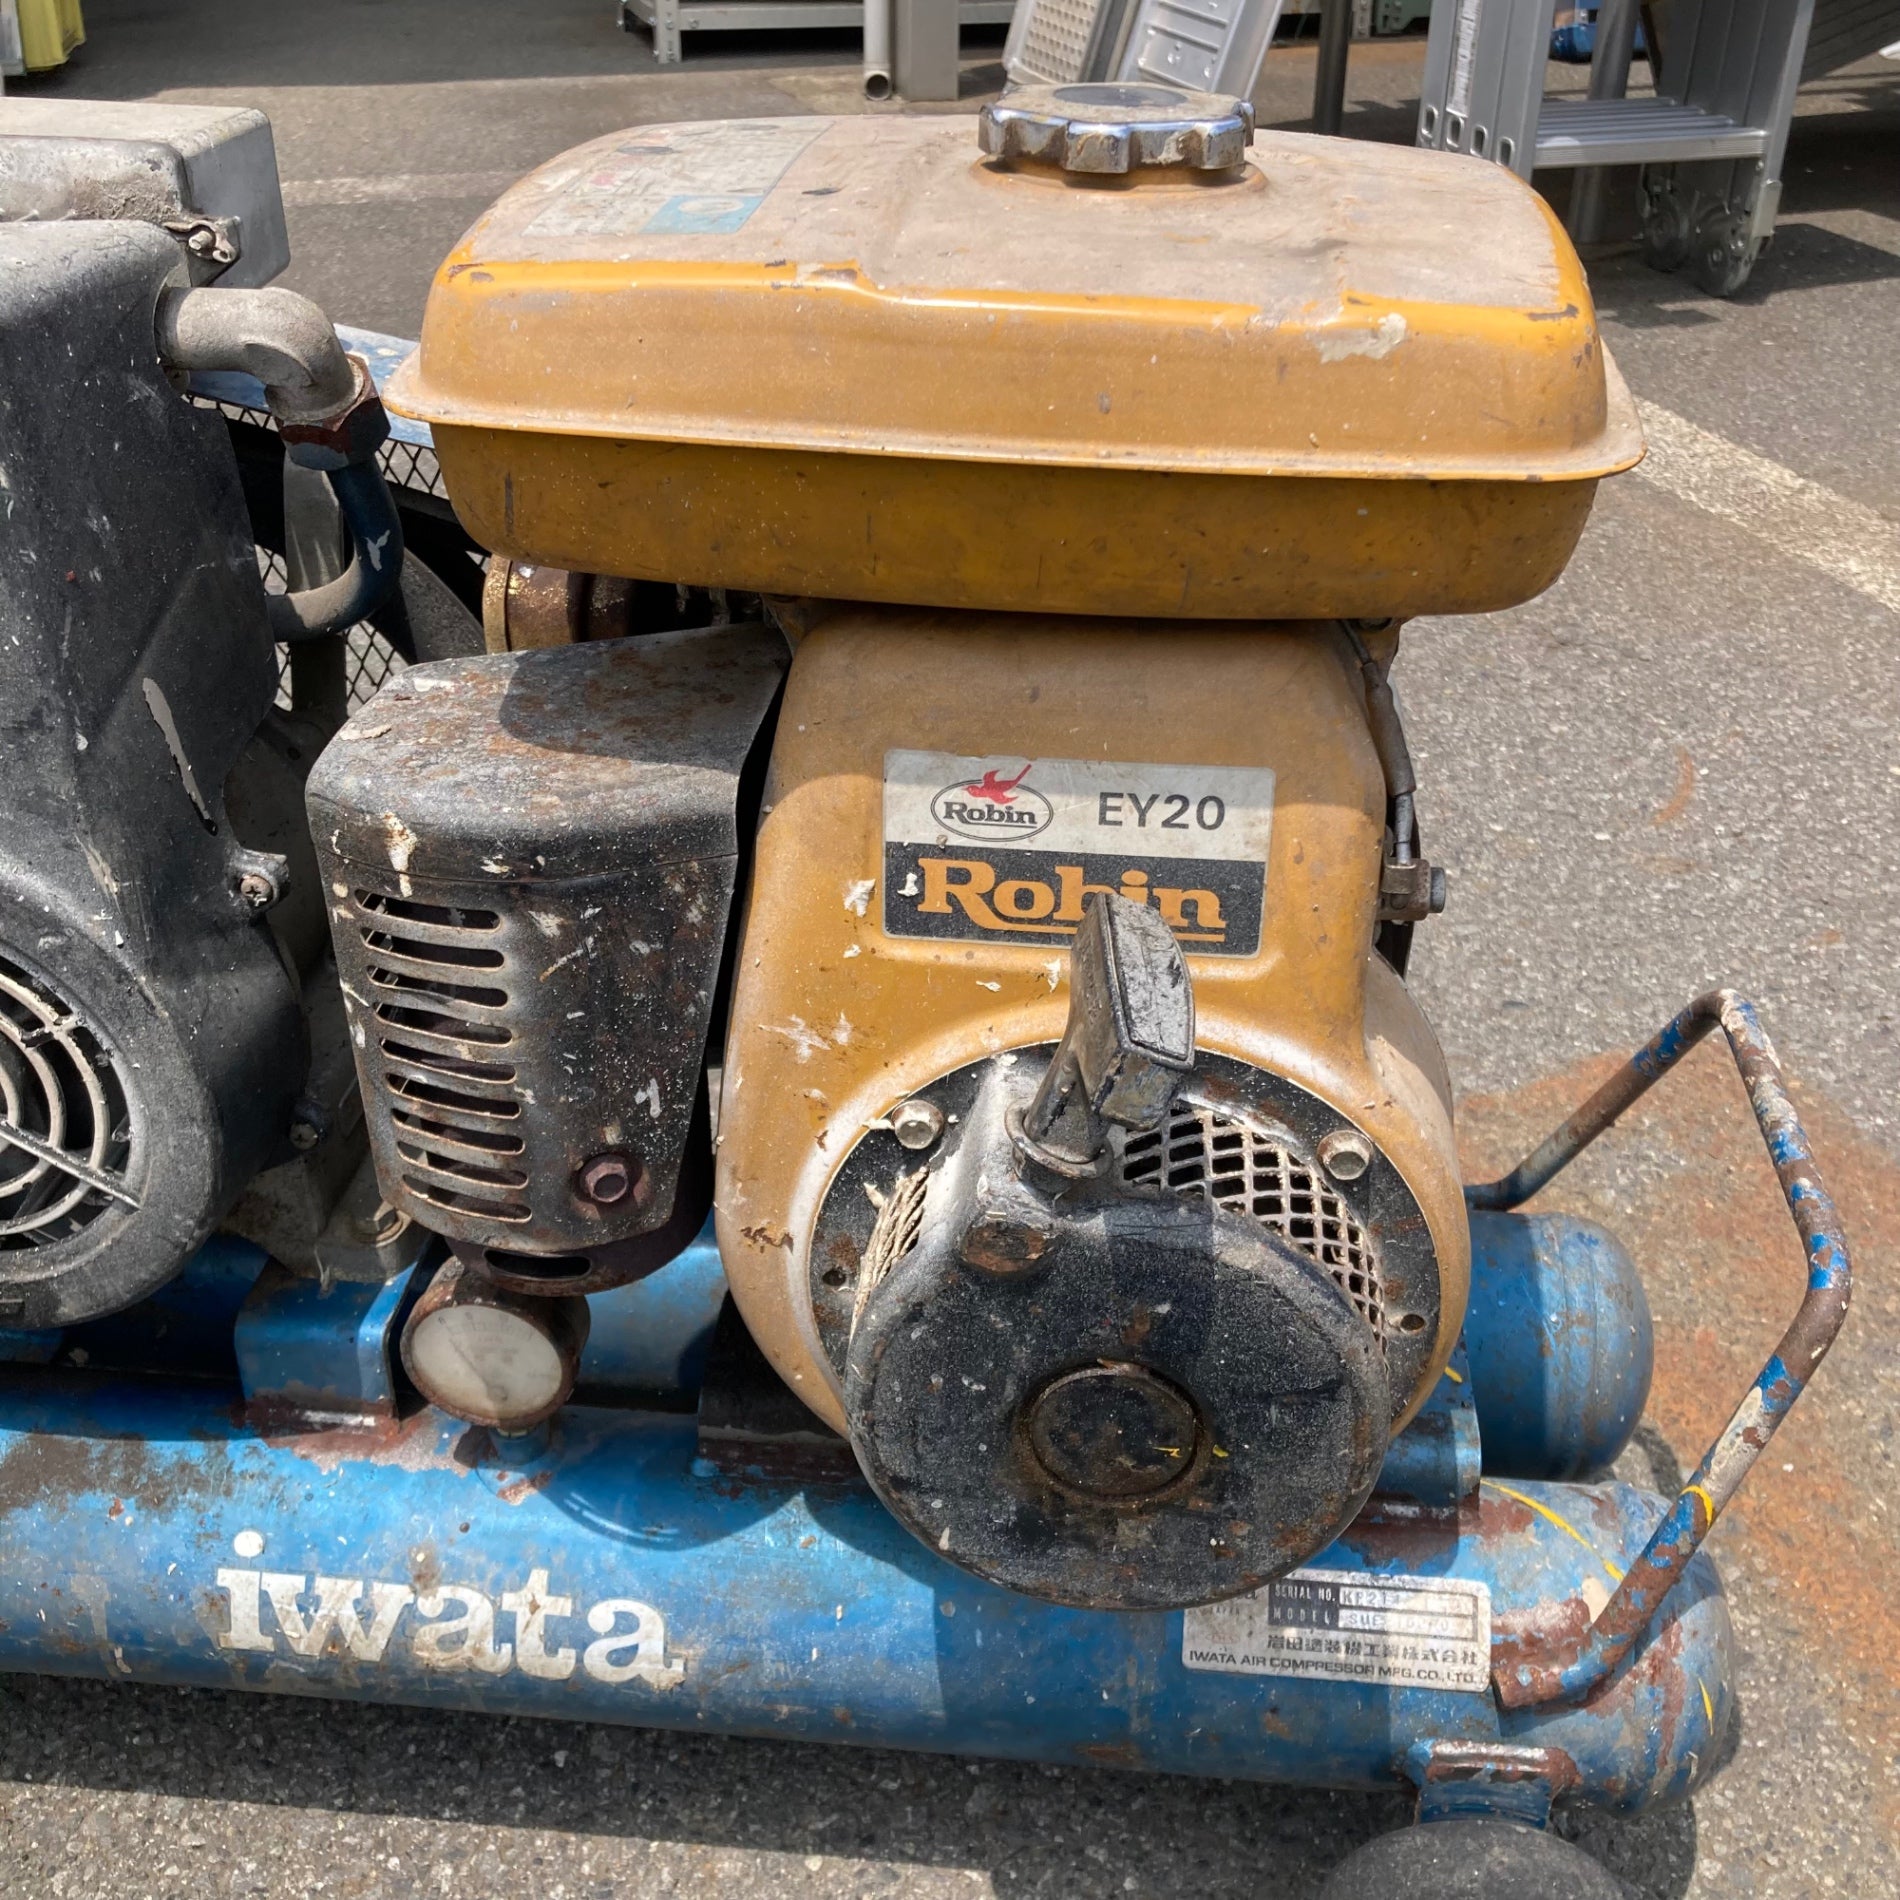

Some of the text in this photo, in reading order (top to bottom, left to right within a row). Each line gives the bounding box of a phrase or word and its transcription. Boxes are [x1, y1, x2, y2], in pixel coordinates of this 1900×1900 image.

[943, 801, 1038, 829] Robin
[1099, 791, 1226, 831] EY20
[917, 857, 1227, 942] Robin
[1275, 1584, 1311, 1600] SERIAL
[1318, 1587, 1336, 1602] NO.
[216, 1530, 686, 1690] iwata
[1273, 1607, 1330, 1625] MODEL
[1189, 1650, 1237, 1665] IWATA
[1240, 1654, 1267, 1667] AIR
[1269, 1657, 1375, 1675] COMPRESSOR
